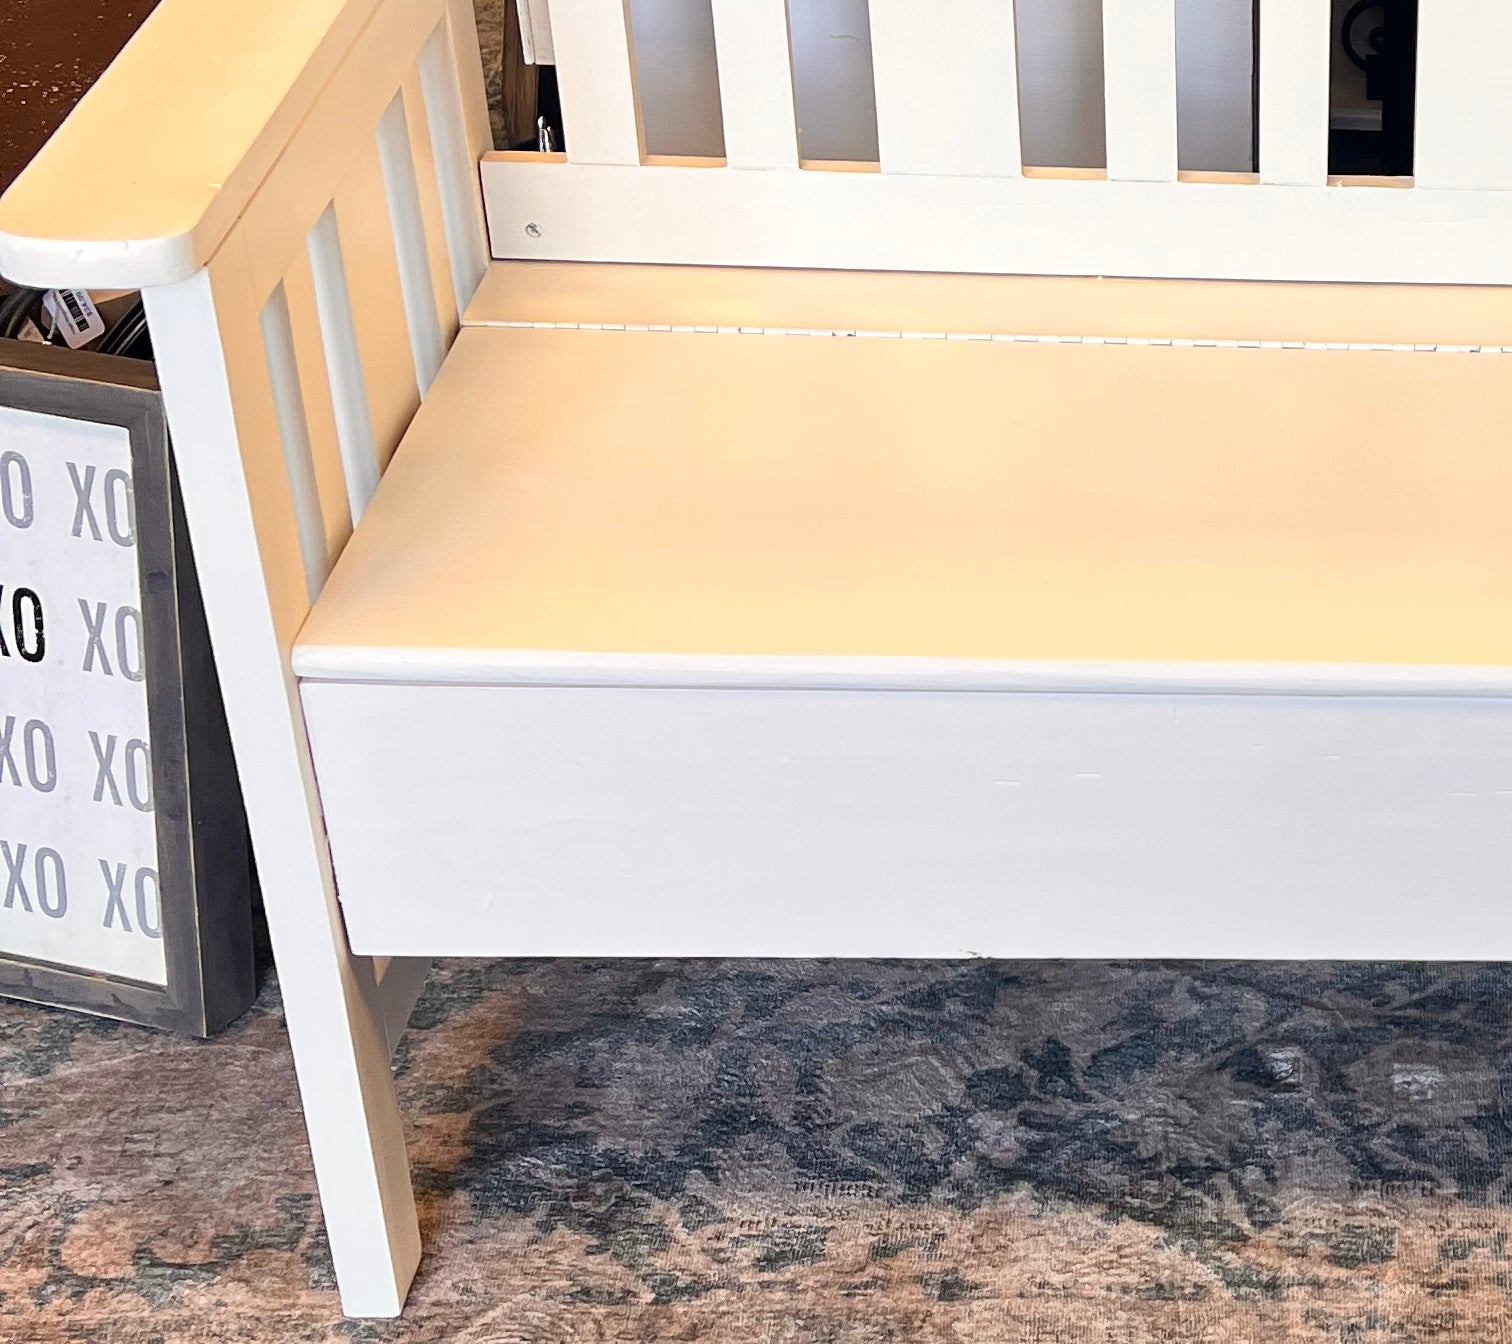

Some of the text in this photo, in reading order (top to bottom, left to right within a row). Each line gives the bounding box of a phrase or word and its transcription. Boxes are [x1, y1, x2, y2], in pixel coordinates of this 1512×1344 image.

[65, 461, 136, 548] XO
[0, 584, 146, 683] O XO
[0, 715, 155, 813] XO XO
[0, 839, 164, 940] XO XO
